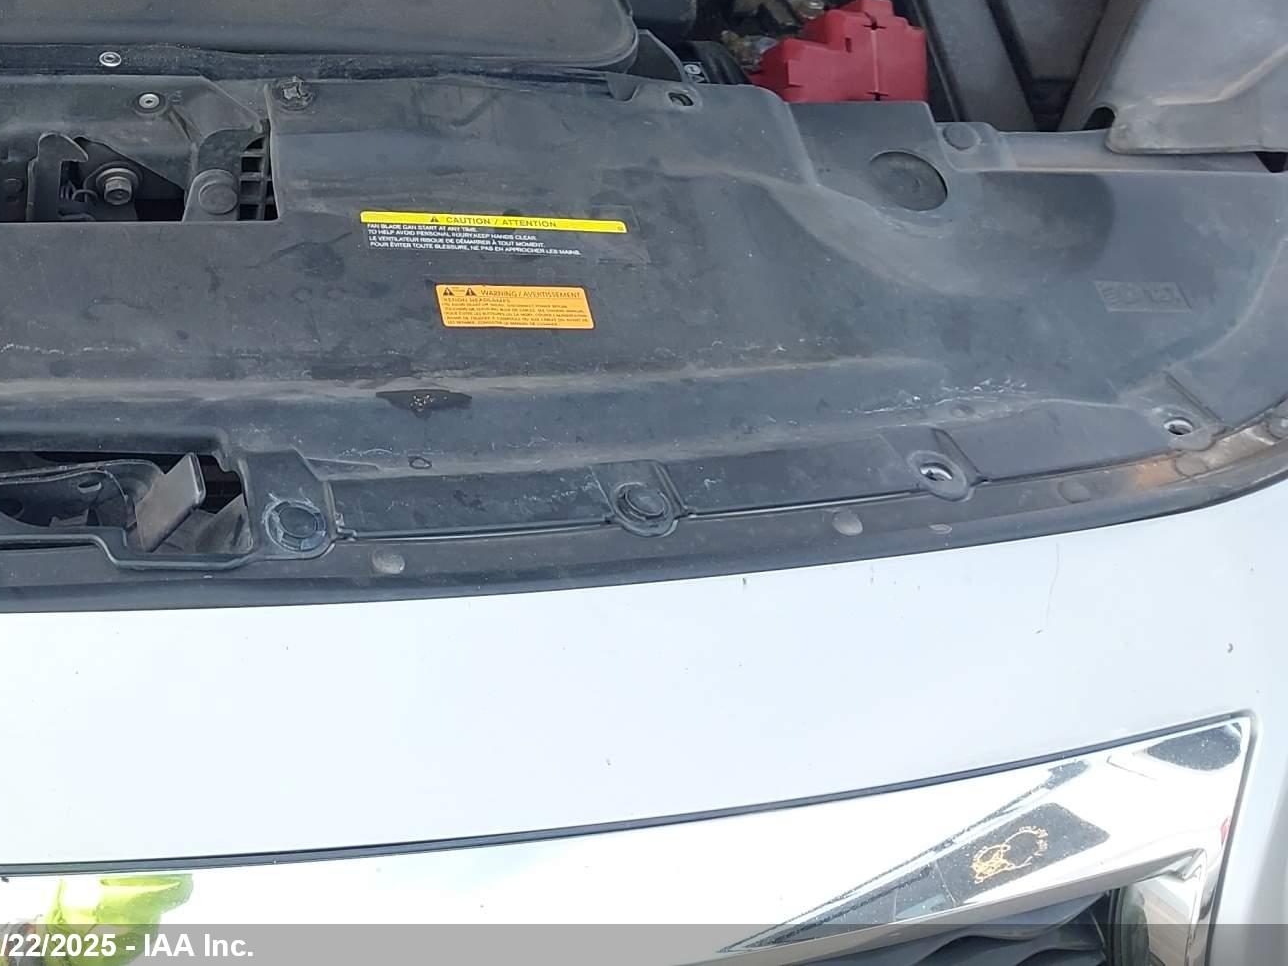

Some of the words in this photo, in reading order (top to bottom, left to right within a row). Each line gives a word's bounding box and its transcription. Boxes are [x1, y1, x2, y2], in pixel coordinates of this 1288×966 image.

[446, 217, 491, 225] CAUTION
[502, 219, 557, 228] ATTENTION
[480, 289, 517, 297] WARNING
